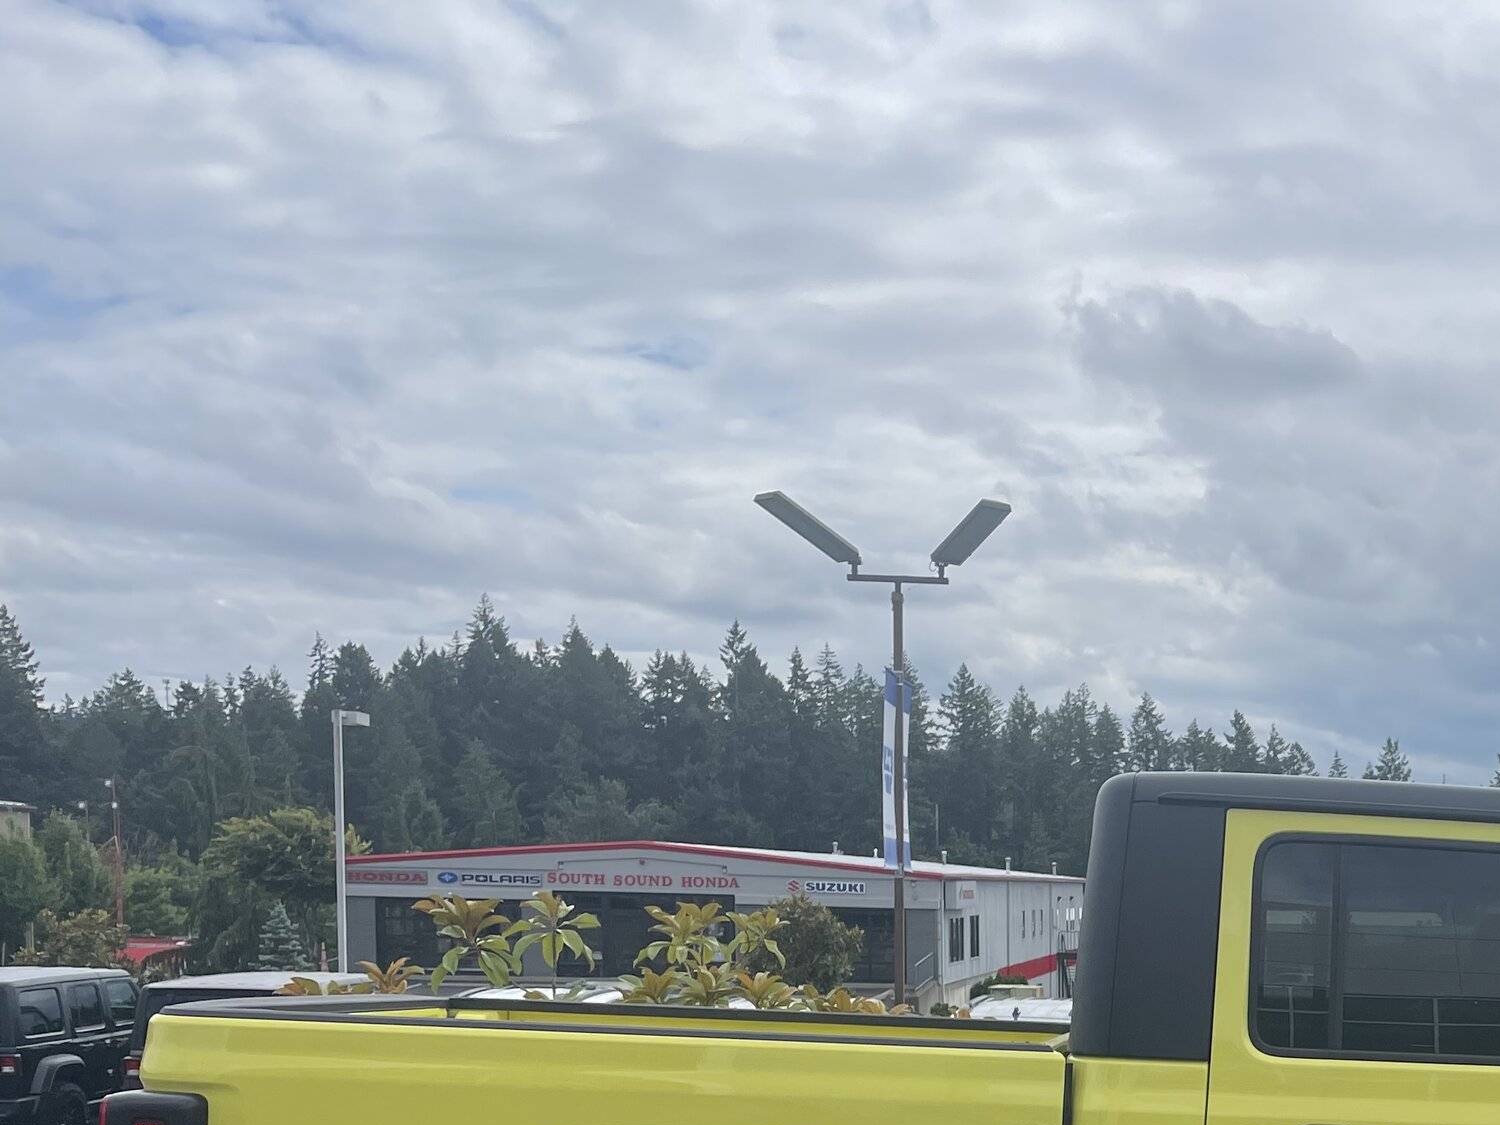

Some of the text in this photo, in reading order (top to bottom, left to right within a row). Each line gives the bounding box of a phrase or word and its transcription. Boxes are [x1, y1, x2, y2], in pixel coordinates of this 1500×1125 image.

[348, 872, 426, 881] HONDA
[461, 873, 541, 884] POLARIS
[547, 871, 741, 889] SOUTH SOUND HONDA
[806, 882, 864, 892] SUZUKI
